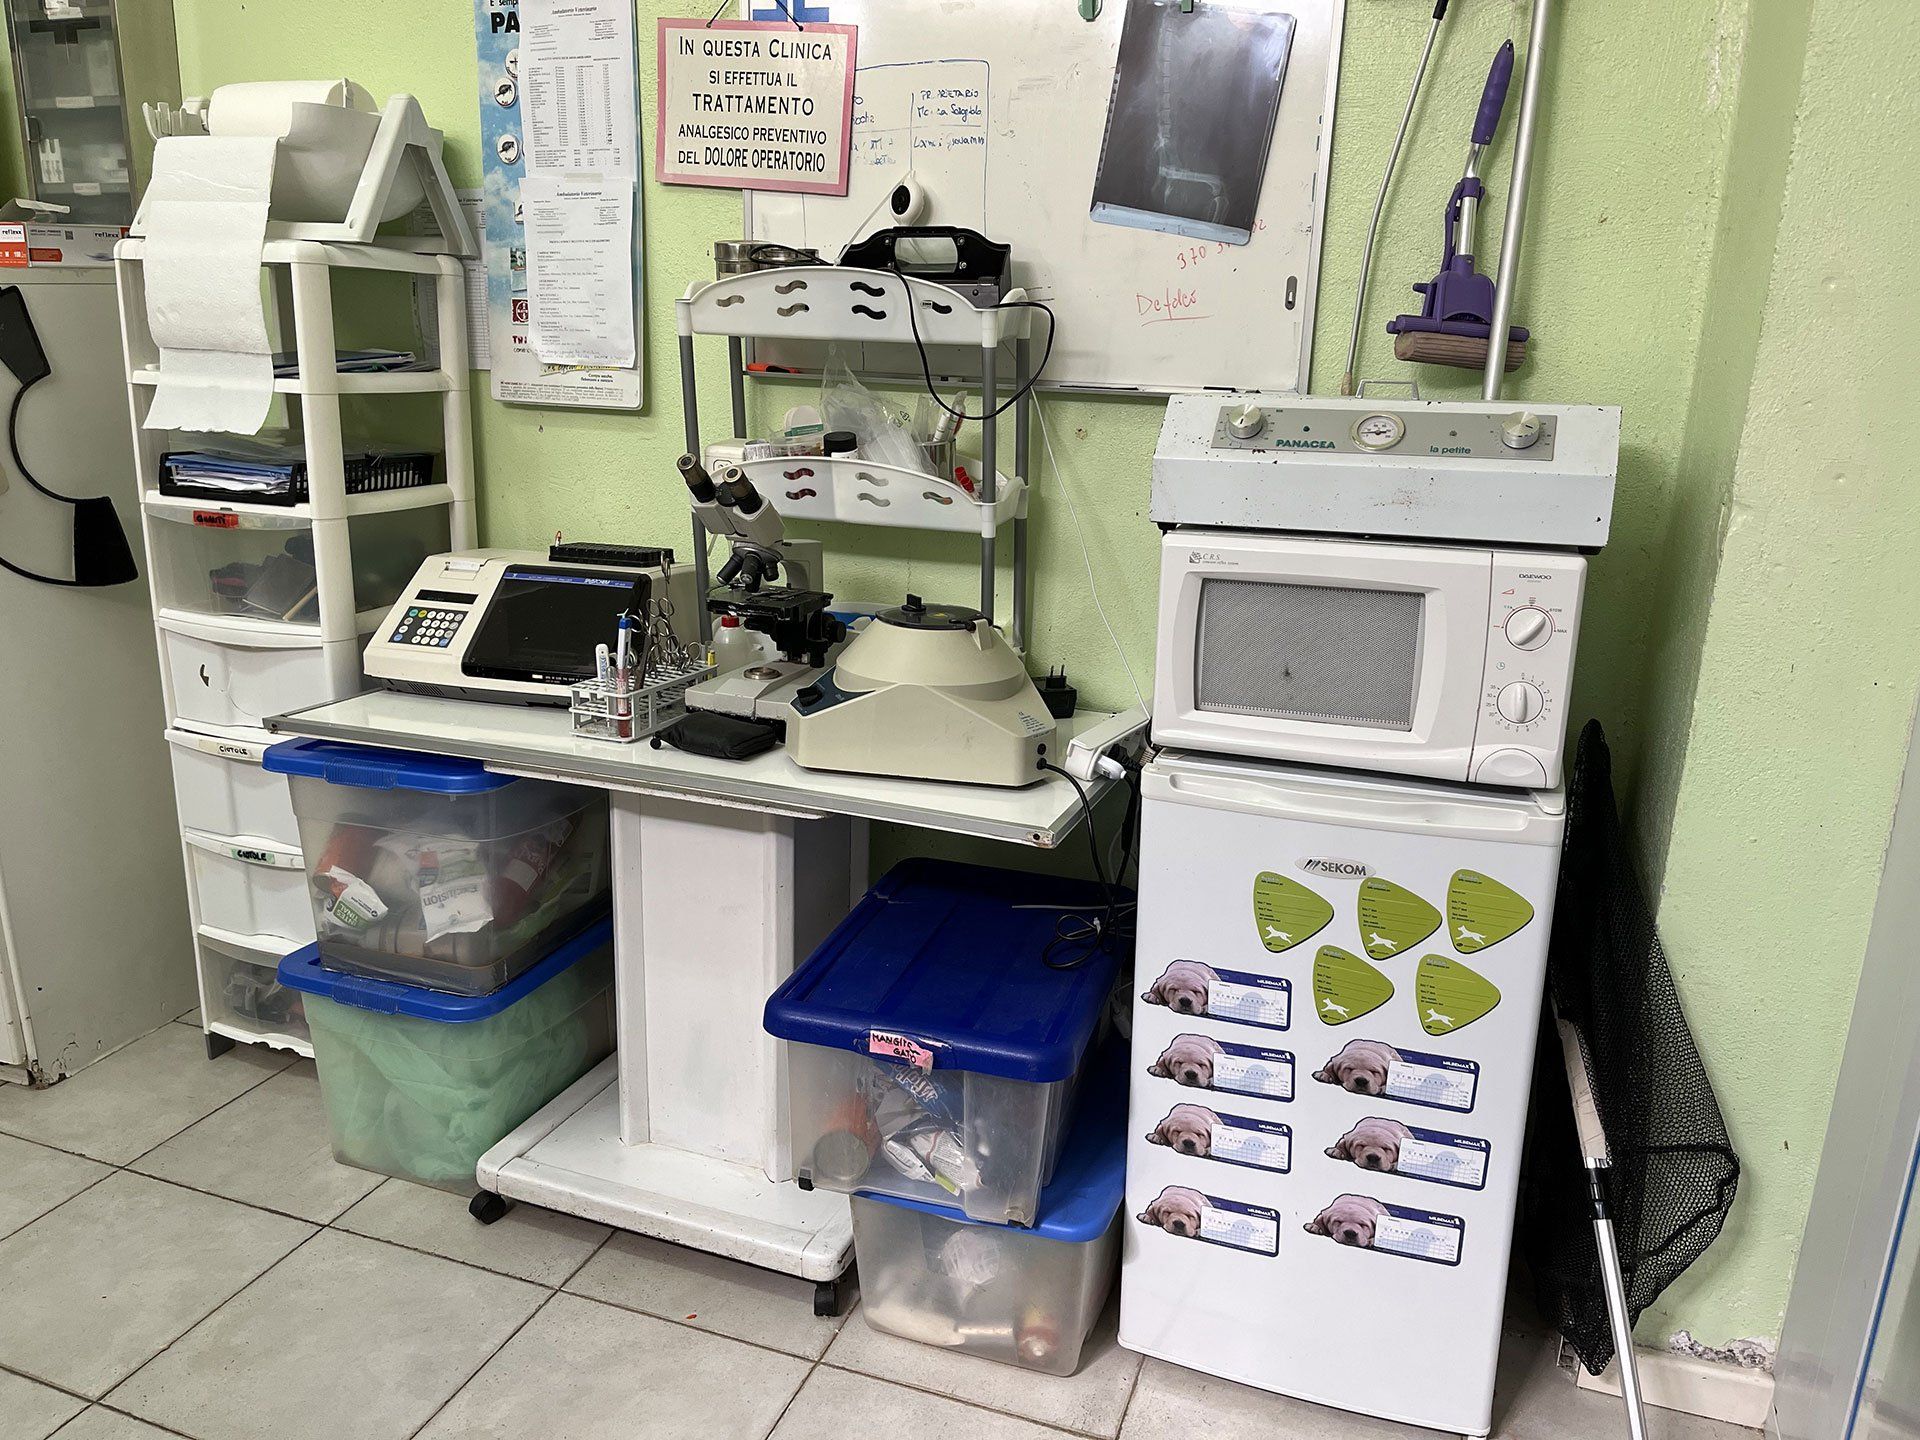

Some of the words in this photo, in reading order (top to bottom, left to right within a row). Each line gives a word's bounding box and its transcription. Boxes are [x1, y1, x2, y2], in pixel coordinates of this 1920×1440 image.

[703, 40, 760, 58] QUESTA
[709, 70, 721, 85] SI
[724, 71, 783, 87] EFFETTUA
[692, 93, 815, 117] TRATTAMENTO
[678, 123, 750, 141] ANALGESICO
[752, 127, 828, 146] PREVENTIVO
[678, 150, 701, 165] DEL
[704, 146, 748, 169] DOLORE
[751, 149, 826, 173] OPERATORIO
[94, 231, 119, 239] reflexx
[1276, 439, 1336, 449] PANACEA
[1429, 445, 1439, 454] la
[1441, 446, 1472, 455] petite
[1320, 861, 1367, 876] SEKOM
